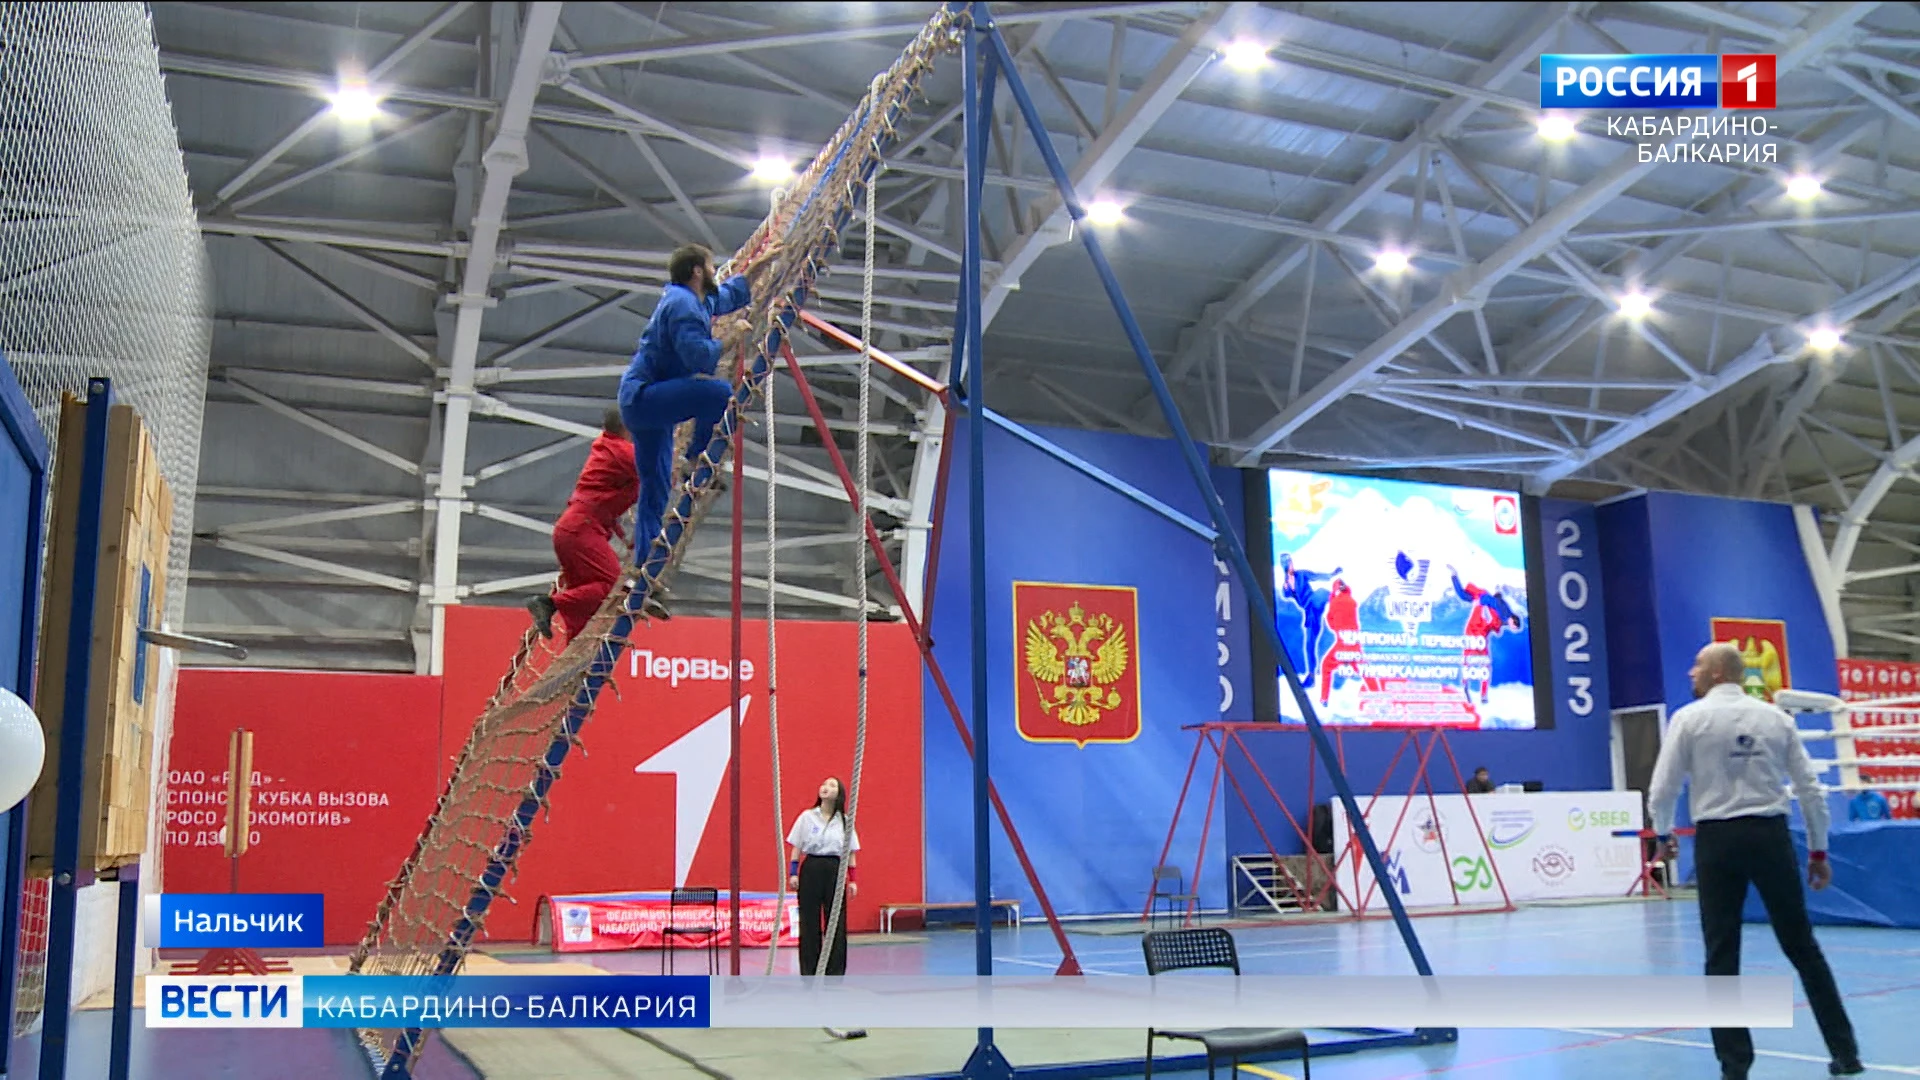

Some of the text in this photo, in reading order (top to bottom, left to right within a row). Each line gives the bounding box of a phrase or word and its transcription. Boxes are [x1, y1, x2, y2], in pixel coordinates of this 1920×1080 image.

[1556, 518, 1594, 717] 2023
[630, 649, 755, 688] Первые
[168, 770, 205, 785] ОАО
[211, 770, 272, 787] «РД»
[167, 790, 390, 807] СПОНС КУБКА ВЫЗОВА
[166, 810, 351, 826] РФСО «ОКОМОТИВ»
[1589, 810, 1631, 827] SBER
[165, 831, 261, 847] ПО ДЗО
